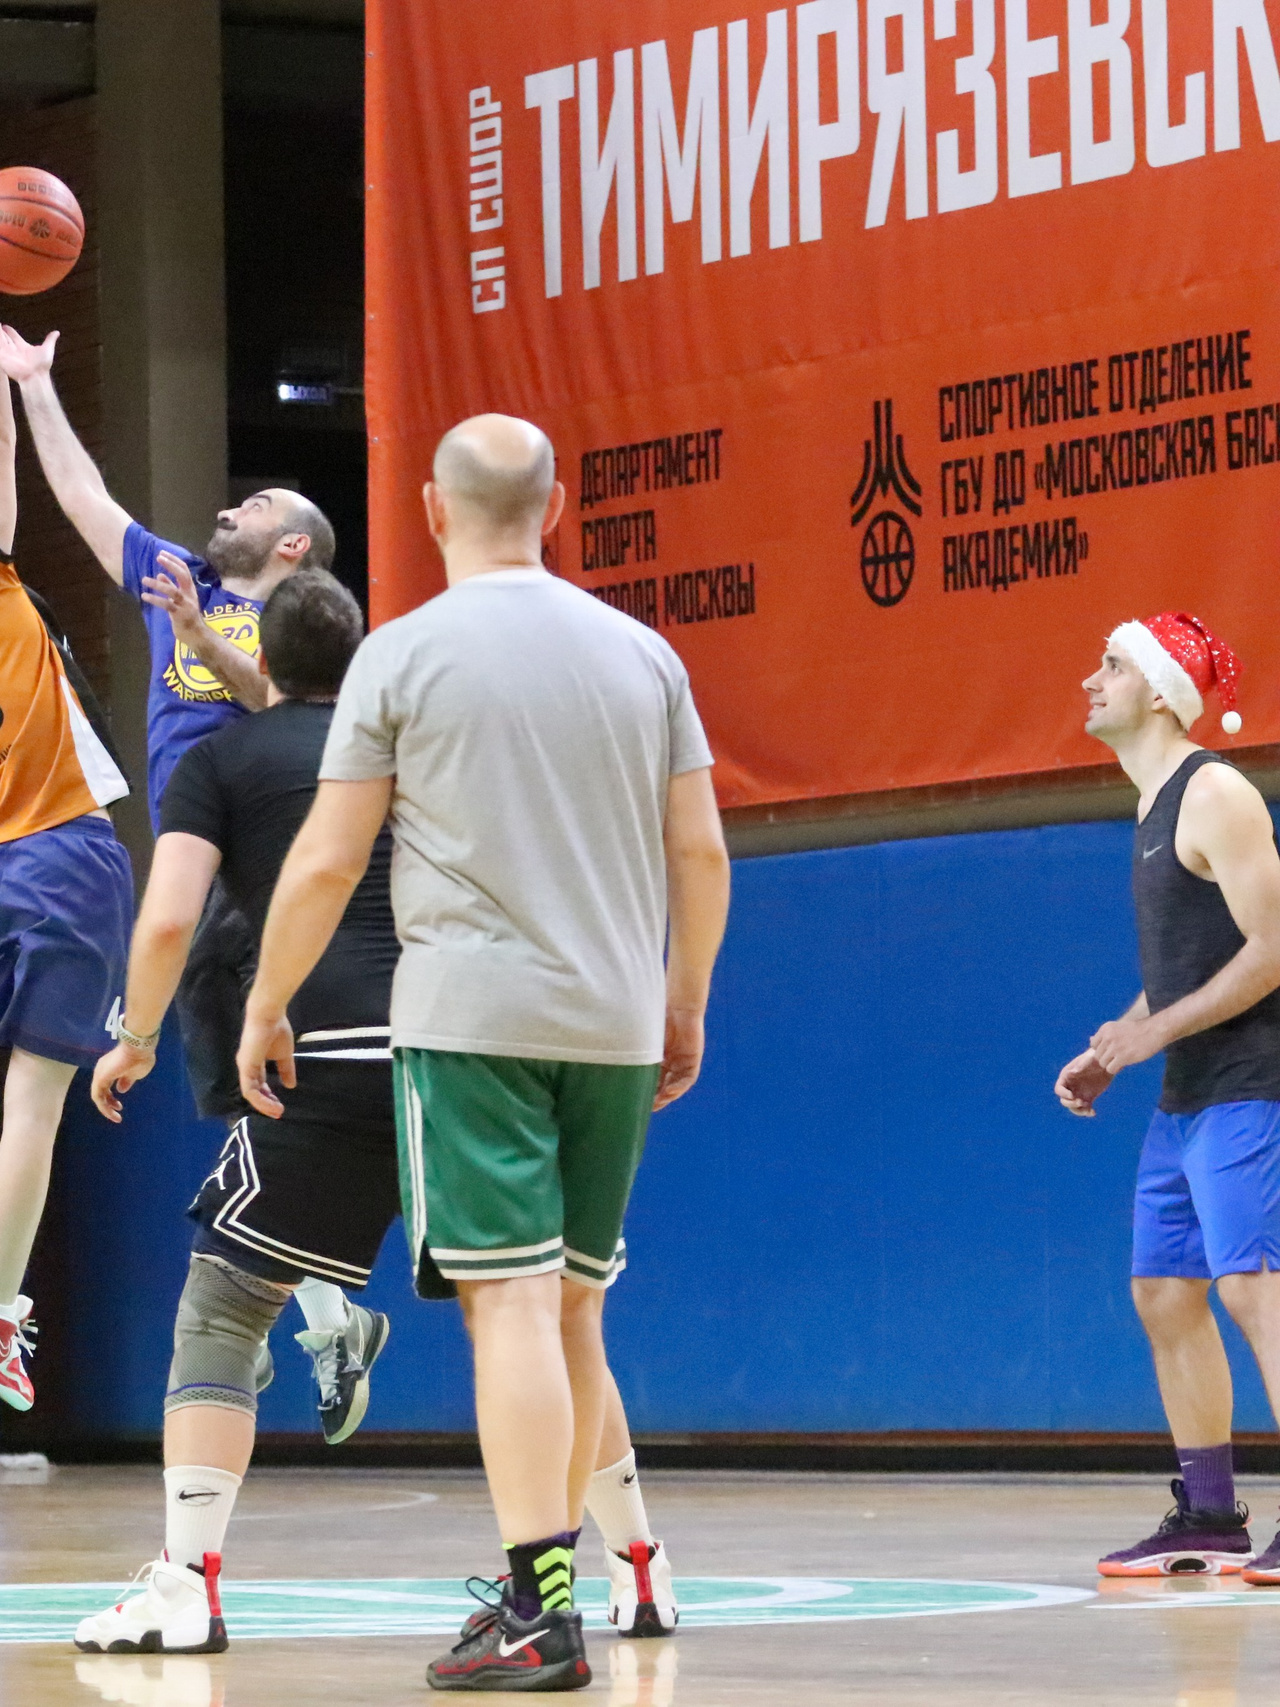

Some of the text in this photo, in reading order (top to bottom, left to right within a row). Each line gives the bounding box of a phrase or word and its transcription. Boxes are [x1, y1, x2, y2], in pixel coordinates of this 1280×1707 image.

[469, 86, 506, 314] СП СШОР
[939, 330, 1253, 442] СПОРТИВНОЕ ОТДЕЛЕНИЕ
[580, 428, 723, 511] ДЕПАРТАМЕНТ
[941, 456, 984, 518] ГБУ
[992, 449, 1026, 517] ДО
[1034, 414, 1217, 500] «МОСКОВСКАЯ
[581, 509, 657, 572] СПОРТА
[942, 516, 1089, 592] АКАДЕМИЯ»
[663, 562, 756, 626] МОСКВЫ
